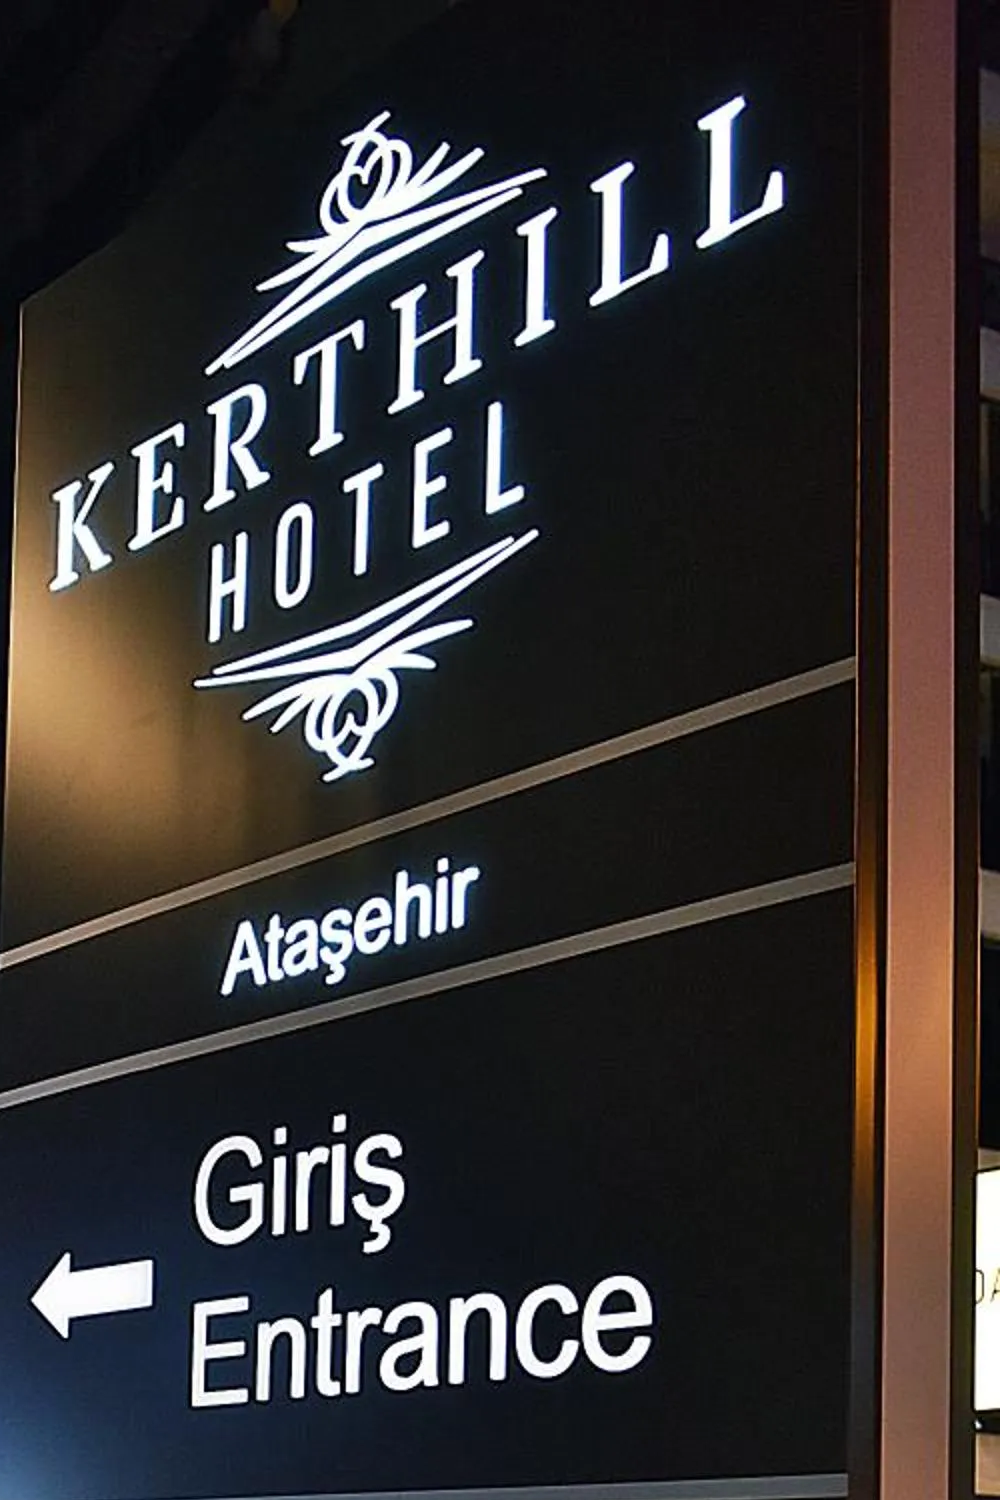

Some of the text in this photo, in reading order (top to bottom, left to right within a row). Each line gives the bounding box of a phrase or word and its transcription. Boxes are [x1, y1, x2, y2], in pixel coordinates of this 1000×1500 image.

[47, 95, 785, 594] KERTHILL
[207, 401, 526, 643] HOTEL
[220, 857, 481, 996] Ataşehir
[193, 1114, 406, 1254] Giriş
[190, 1274, 654, 1408] Entrance
